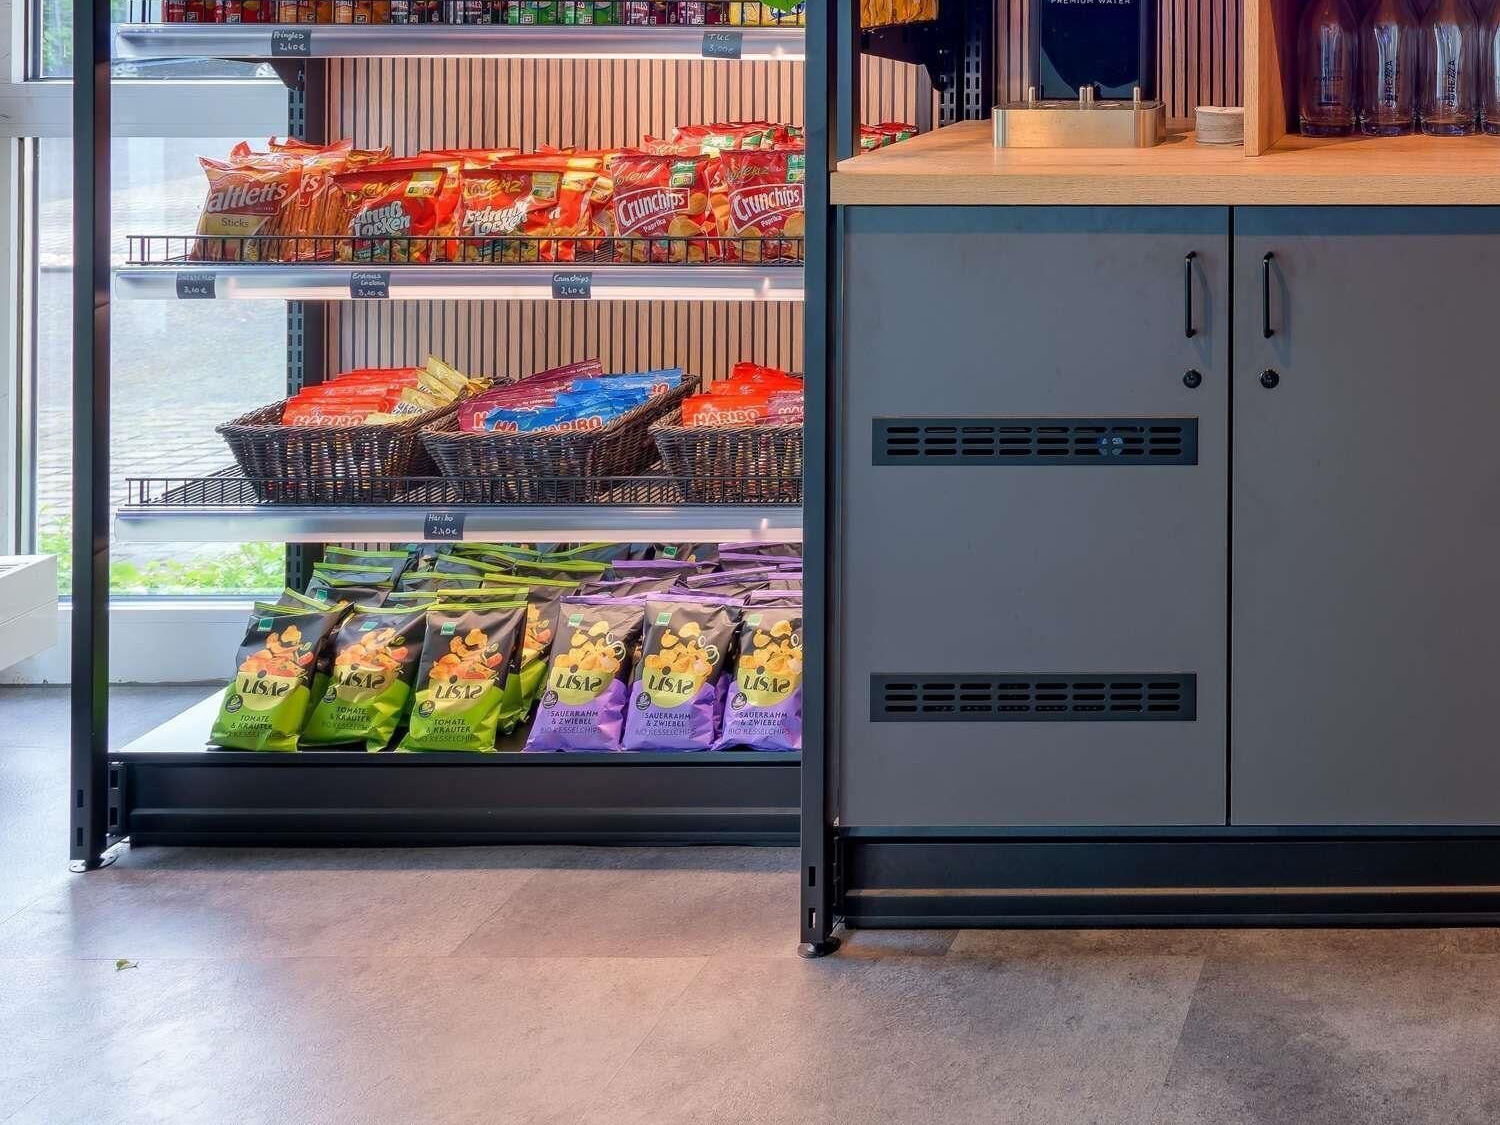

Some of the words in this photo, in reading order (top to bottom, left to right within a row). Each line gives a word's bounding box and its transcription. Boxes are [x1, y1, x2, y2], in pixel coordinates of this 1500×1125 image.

[207, 182, 289, 213] altletts
[733, 188, 800, 222] Crunchips
[619, 190, 685, 226] Crunchips
[221, 217, 249, 227] Sticks
[643, 217, 667, 233] Paprika
[760, 213, 783, 228] Paprika
[694, 409, 760, 427] HARIBO
[434, 718, 465, 726] TOMATE
[644, 712, 691, 720] SAUERRAHM
[739, 711, 788, 719] SAUERRAHM
